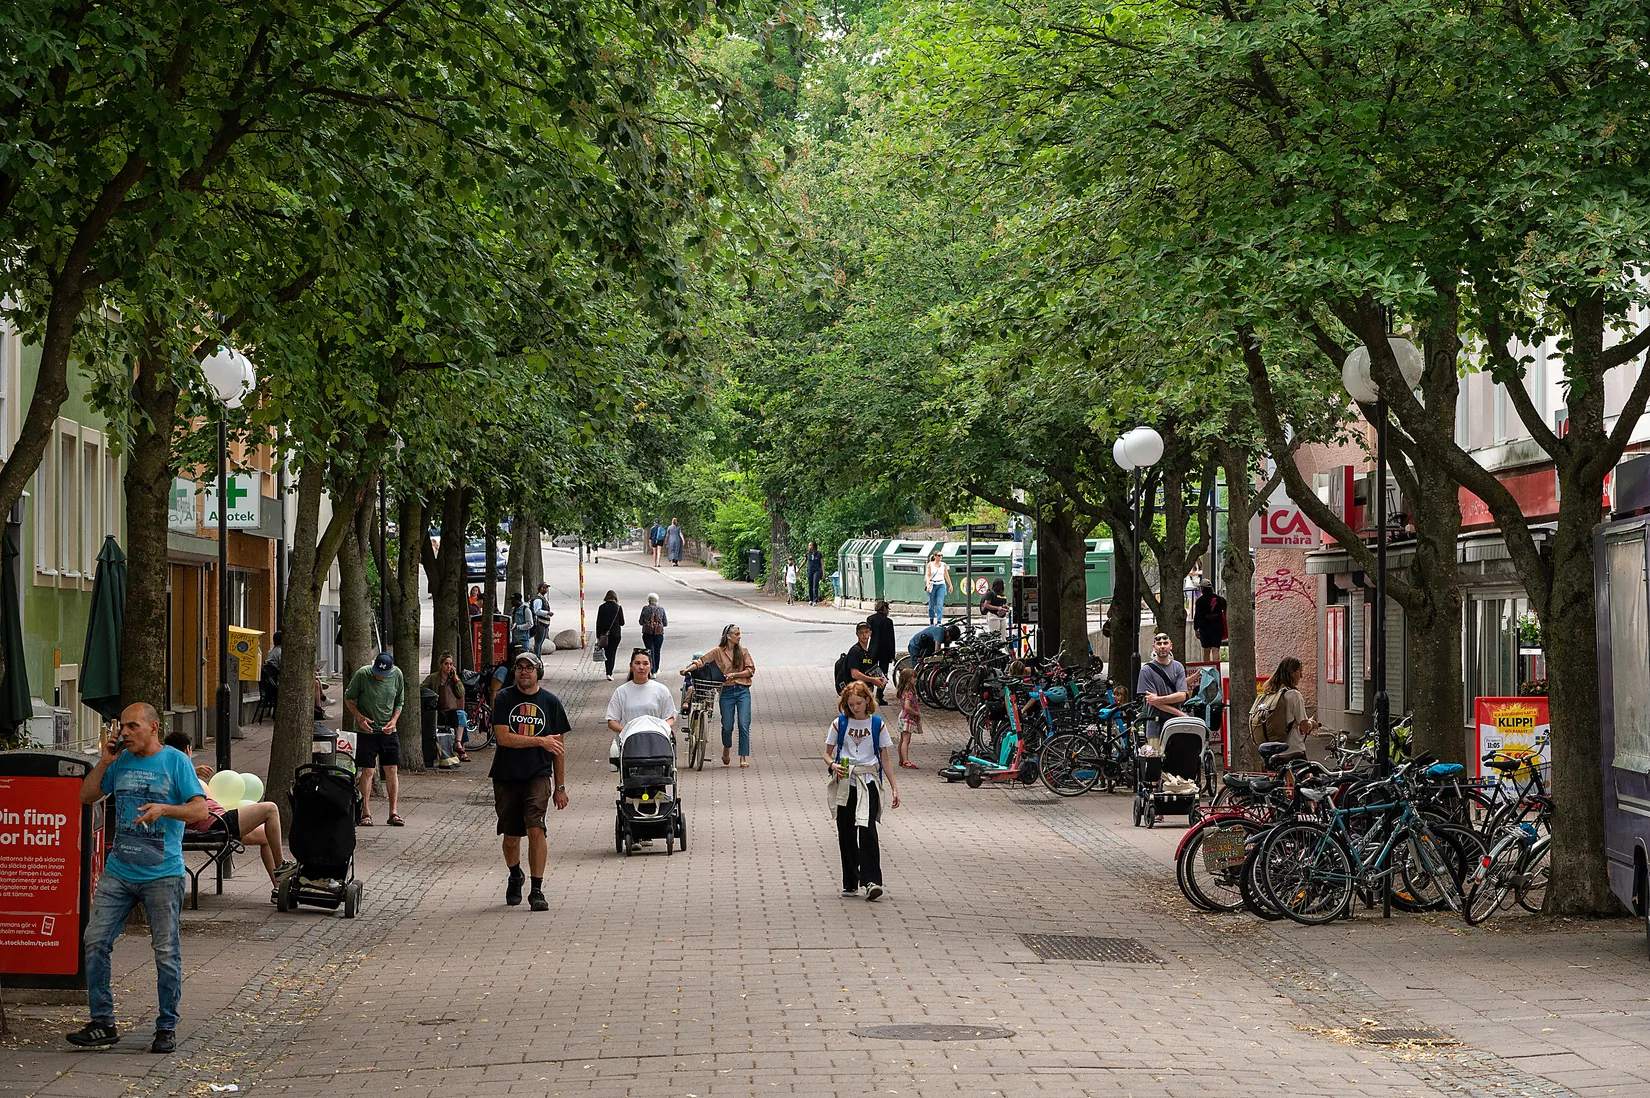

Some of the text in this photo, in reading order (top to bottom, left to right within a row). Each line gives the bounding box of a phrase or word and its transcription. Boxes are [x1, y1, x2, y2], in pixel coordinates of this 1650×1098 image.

[209, 511, 255, 521] Aotek
[1261, 509, 1312, 536] ICA
[1285, 535, 1312, 544] nära
[511, 715, 544, 726] TOYOTA
[1498, 717, 1533, 727] KLIPP!
[0, 808, 67, 829] in fimp
[23, 829, 60, 846] här!
